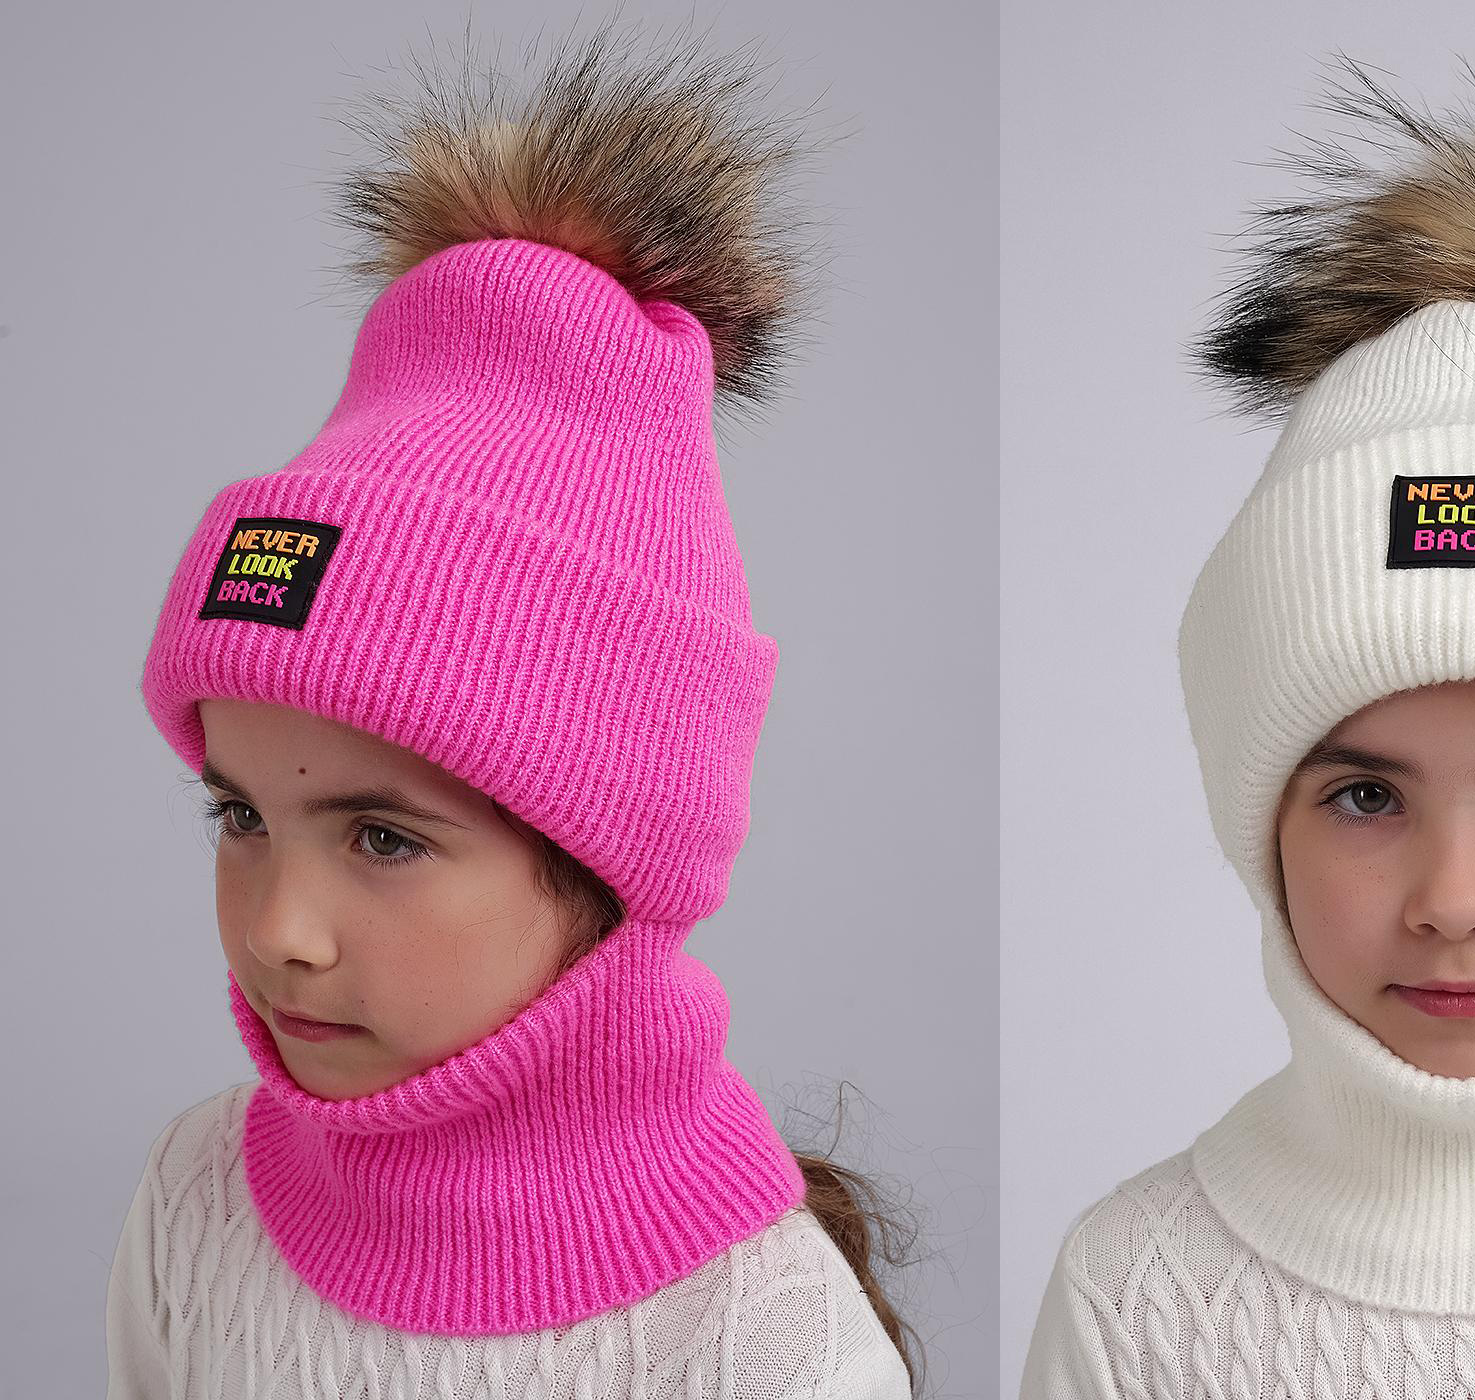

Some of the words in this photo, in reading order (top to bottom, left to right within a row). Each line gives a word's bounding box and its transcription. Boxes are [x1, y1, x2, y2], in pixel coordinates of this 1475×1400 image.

[231, 529, 320, 558] NEVER
[227, 553, 299, 581] LOOK
[216, 580, 289, 609] BACK
